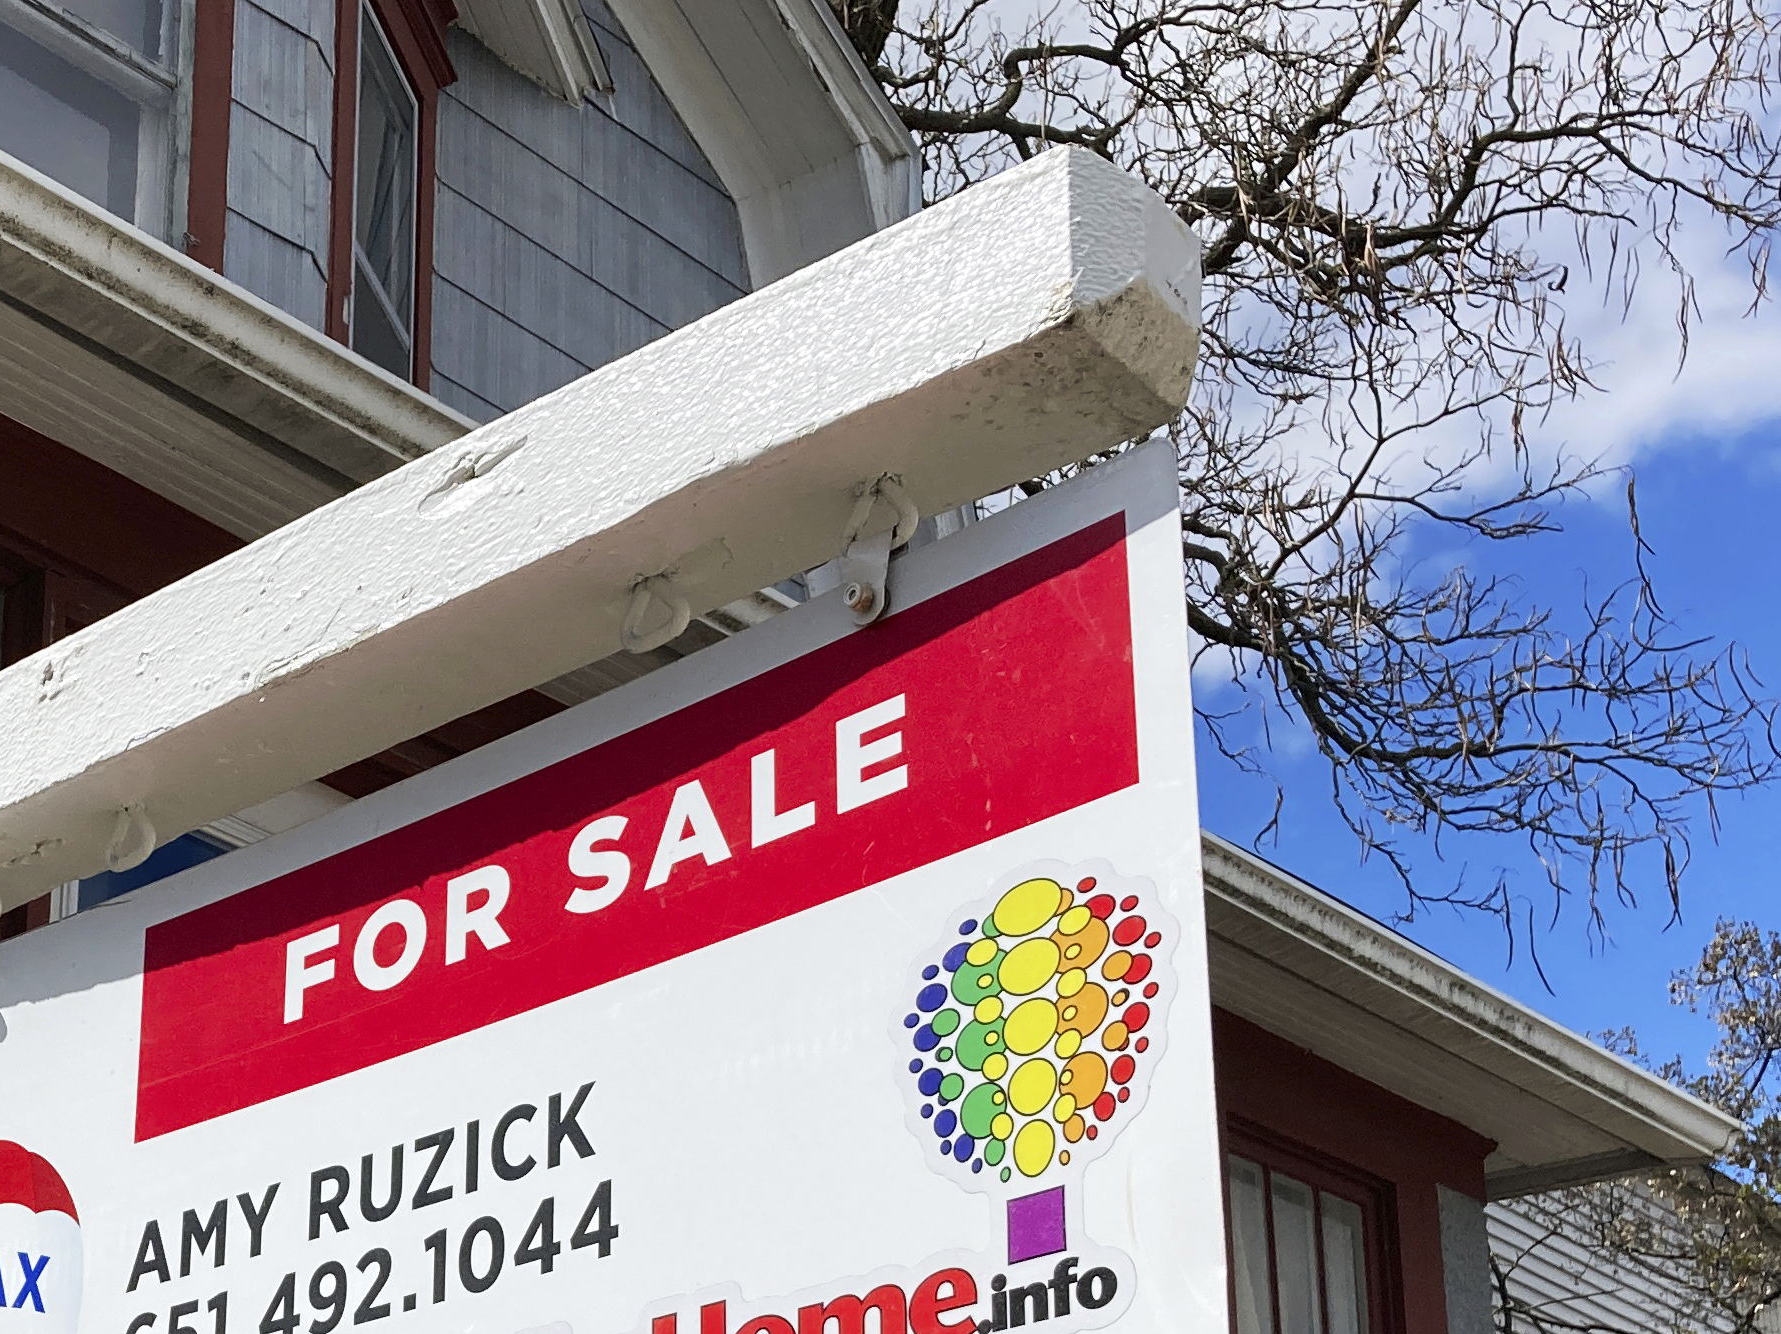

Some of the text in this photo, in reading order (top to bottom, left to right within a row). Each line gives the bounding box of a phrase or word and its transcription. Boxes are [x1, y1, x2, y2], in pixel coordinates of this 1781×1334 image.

[284, 692, 909, 1025] FOR SALE
[125, 1081, 596, 1293] AMY RUZICK
